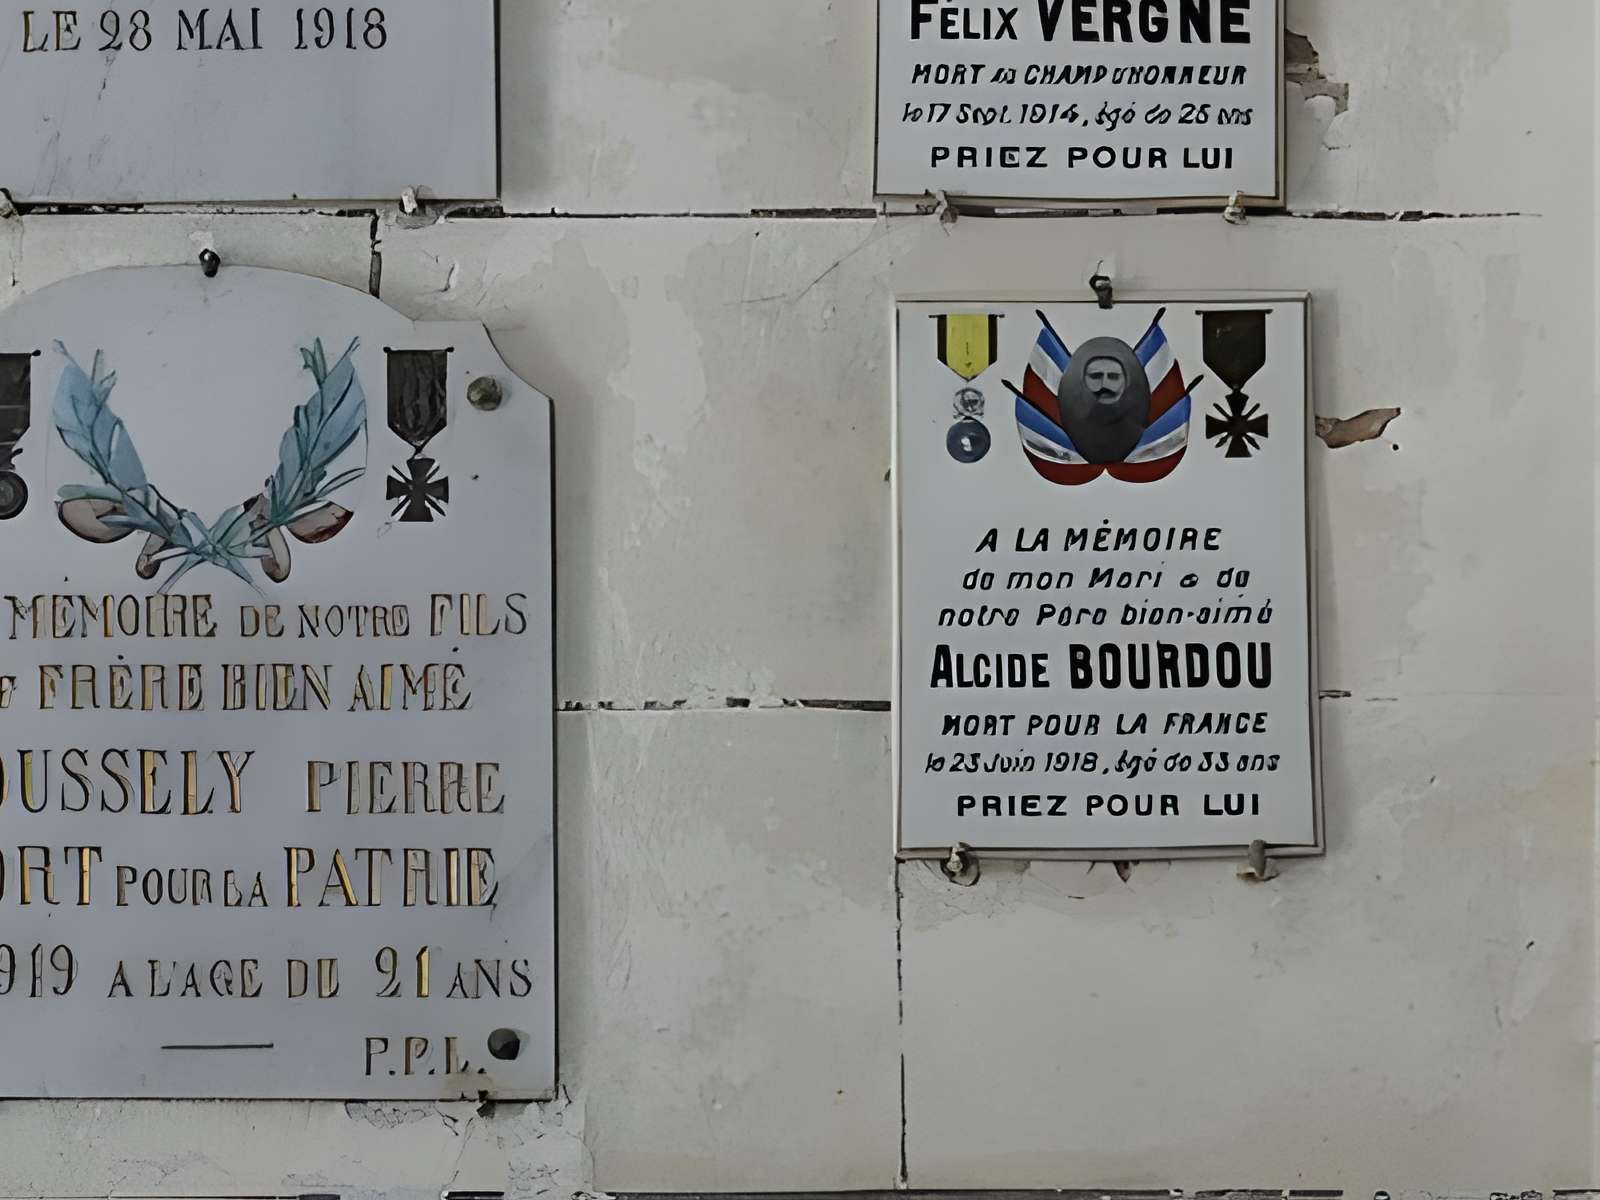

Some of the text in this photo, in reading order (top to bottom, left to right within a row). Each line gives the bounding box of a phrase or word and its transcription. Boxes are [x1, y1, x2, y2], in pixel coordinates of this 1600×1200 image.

[22, 7, 388, 52] LE 28 MAI 1918
[912, 64, 986, 84] MORT
[931, 146, 1233, 168] PRIEZ POUR LUI
[975, 519, 1222, 552] A LA MÉMOIRE
[1007, 571, 1073, 589] mon
[3, 576, 219, 640] MÉMOIRE
[239, 605, 285, 637] DE
[297, 605, 410, 638] NOTRE
[430, 593, 528, 637] FILS
[39, 655, 203, 711] FRÈRE
[222, 664, 332, 711] BIEN
[348, 647, 472, 711] AIMÉ
[1069, 641, 1272, 689] BOURDOU
[942, 712, 1268, 735] MORT POUR LA FRANCE
[305, 760, 505, 815] PIERRE
[957, 794, 1259, 816] PRIEZ POUR LUI
[116, 866, 212, 907] POUR
[224, 869, 269, 908] LA
[283, 846, 500, 909] PATRIE
[107, 959, 133, 997] A
[375, 945, 431, 998] 21
[445, 958, 534, 1000] ANS
